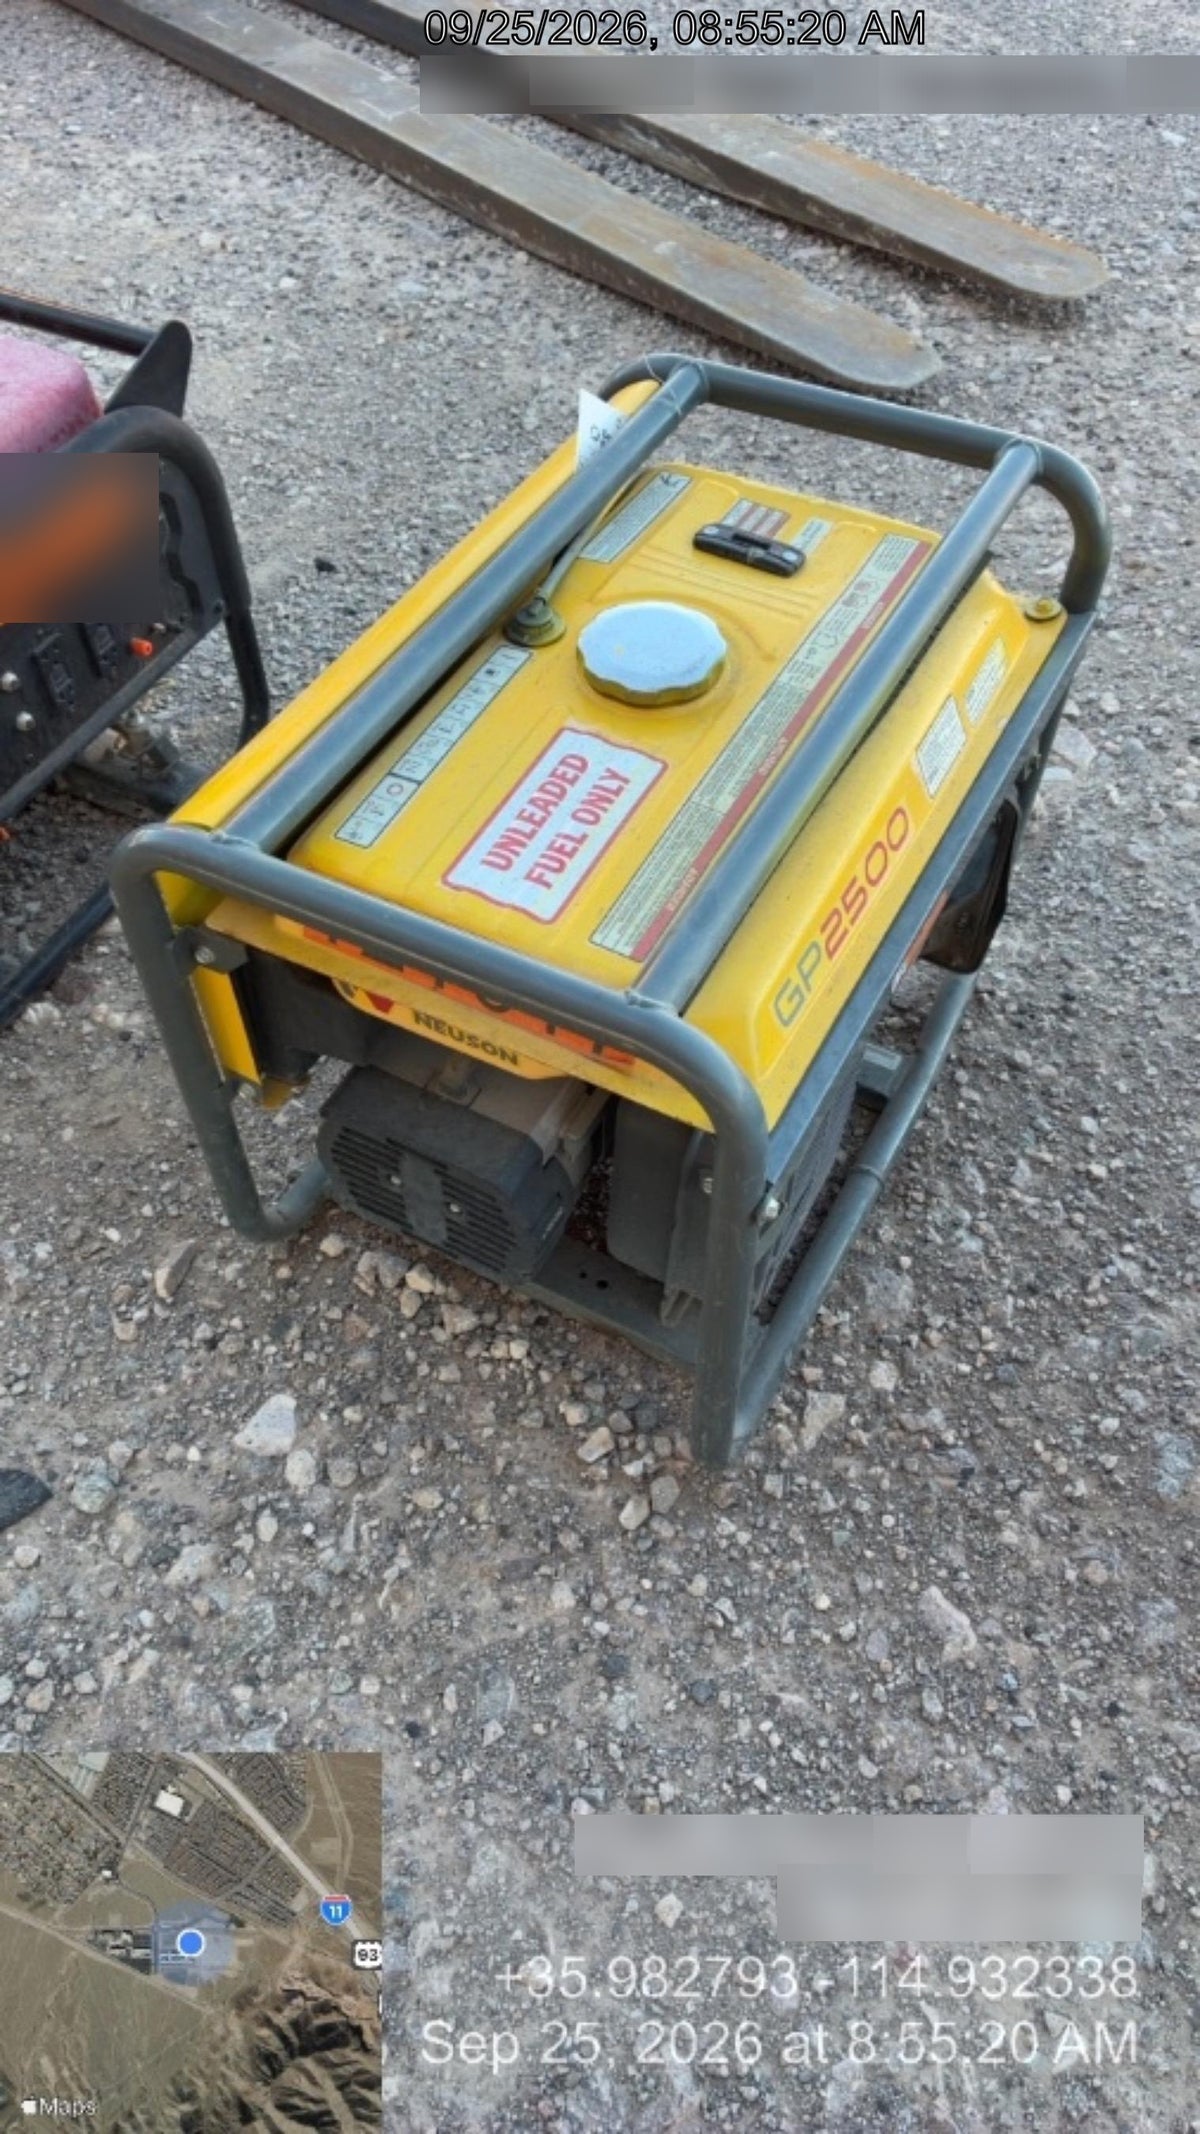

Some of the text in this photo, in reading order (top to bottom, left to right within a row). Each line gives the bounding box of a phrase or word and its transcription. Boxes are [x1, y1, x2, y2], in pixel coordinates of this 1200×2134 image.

[481, 753, 589, 872] UNLEADED
[524, 833, 588, 889] FUEL
[571, 767, 632, 827] ONLY
[774, 806, 911, 1028] GP2500
[412, 1008, 519, 1066] NEUSON
